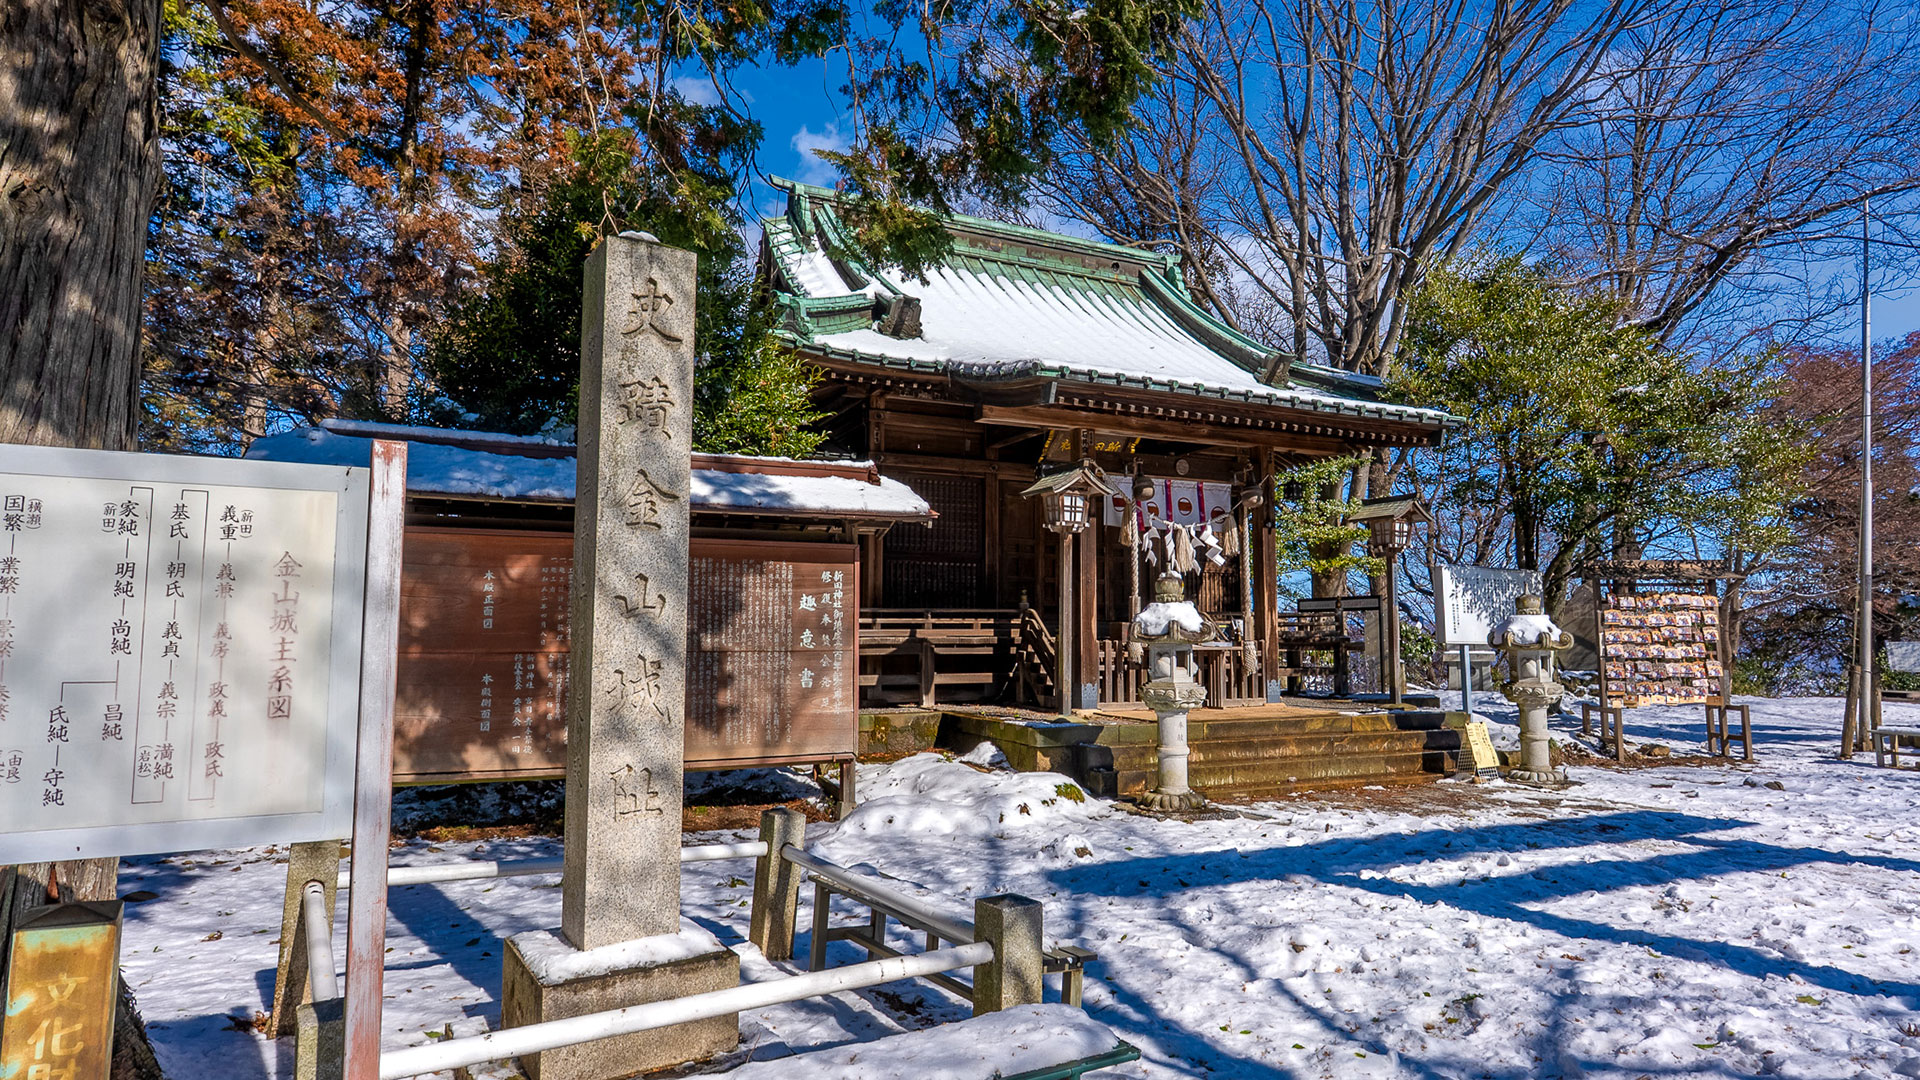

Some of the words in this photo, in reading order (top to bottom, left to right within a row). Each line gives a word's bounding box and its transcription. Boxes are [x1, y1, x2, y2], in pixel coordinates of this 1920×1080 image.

[3, 495, 25, 532] 国繁
[118, 500, 140, 537] 家純
[169, 503, 190, 540] 基氏
[219, 505, 239, 541] 義重
[113, 561, 136, 598] 明純
[165, 562, 186, 598] 朝氏
[215, 563, 236, 599] 義兼
[110, 618, 132, 656] 尚純
[161, 621, 183, 658] 義貞
[210, 622, 232, 659] 義房
[266, 551, 303, 719] 金山城主系図
[798, 593, 817, 689] 趣意書
[157, 681, 179, 719] 義宗
[207, 681, 228, 719] 政義
[46, 705, 69, 744] 氏純
[101, 703, 123, 741] 昌純
[153, 743, 174, 780] 満純
[204, 741, 225, 779] 政氏
[42, 767, 65, 807] 守純
